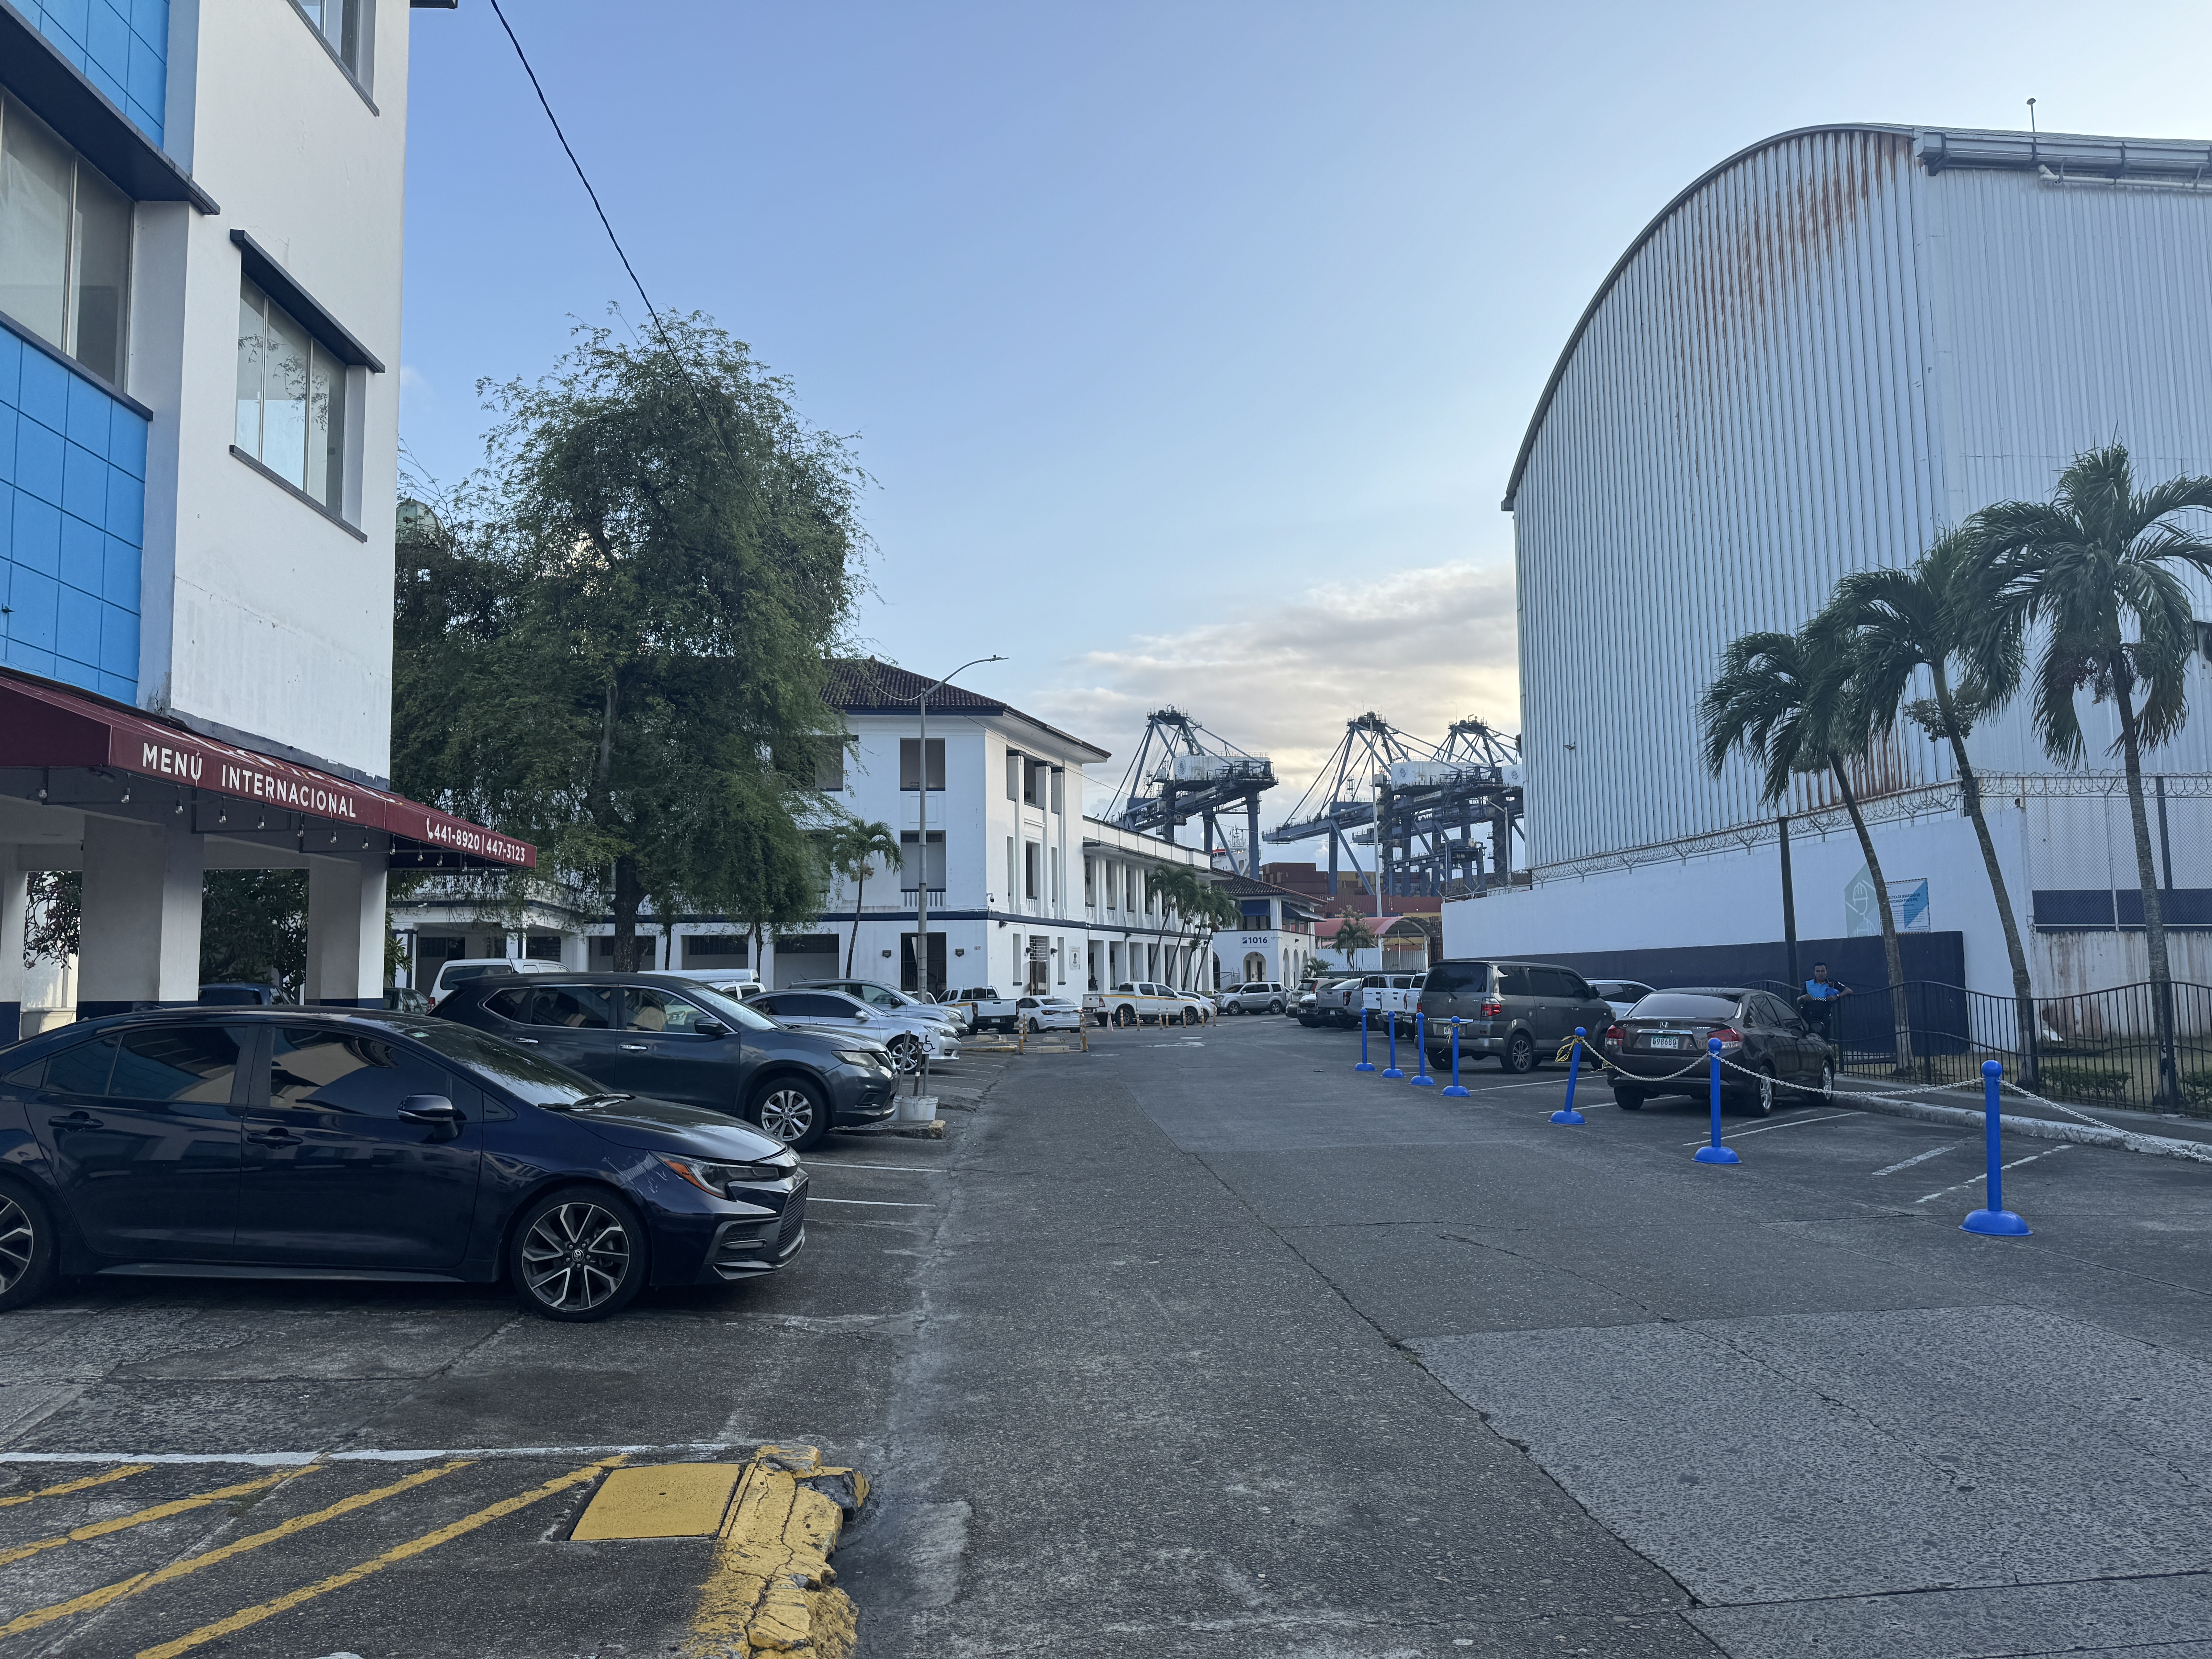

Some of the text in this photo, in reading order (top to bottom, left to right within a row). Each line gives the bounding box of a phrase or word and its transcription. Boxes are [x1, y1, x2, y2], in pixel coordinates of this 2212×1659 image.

[143, 742, 202, 780] MENÚ
[222, 764, 356, 817] INTERNACIONAL
[434, 823, 480, 850] 441-8920
[486, 838, 525, 862] 447-3123
